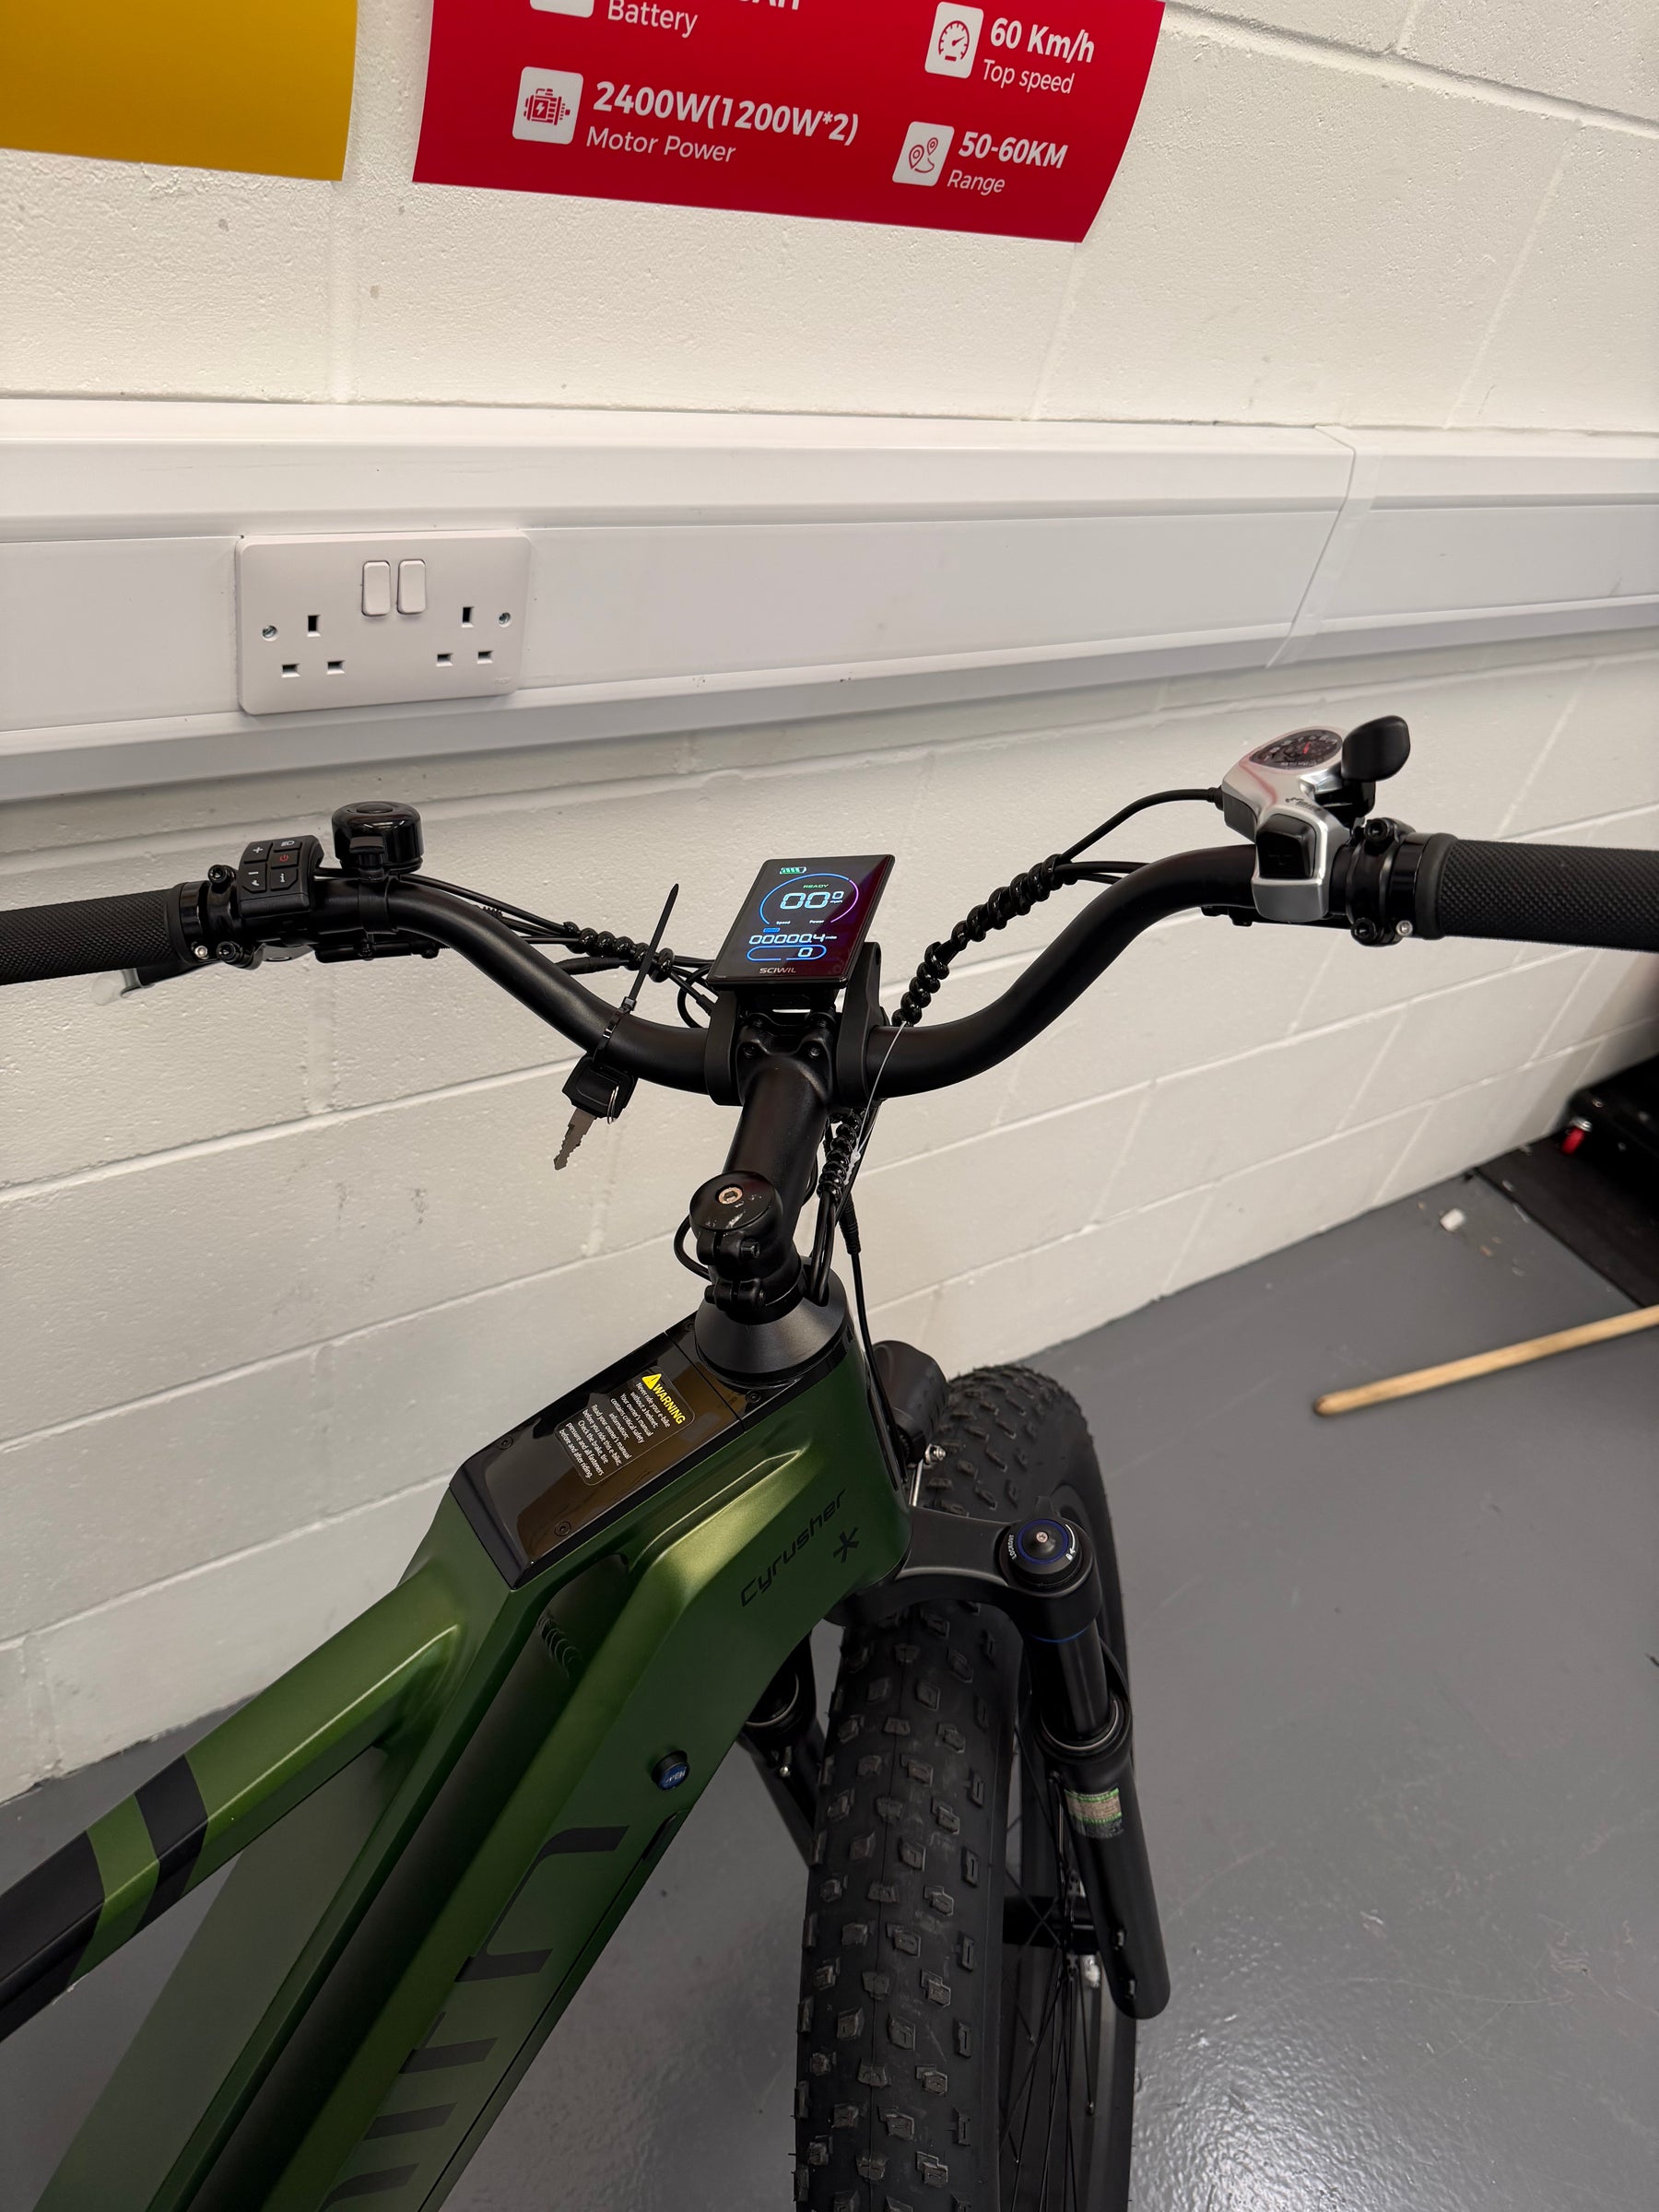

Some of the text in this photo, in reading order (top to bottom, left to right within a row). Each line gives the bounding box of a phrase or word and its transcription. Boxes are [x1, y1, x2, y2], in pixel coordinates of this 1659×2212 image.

[607, 0, 699, 39] Battery
[990, 18, 1095, 63] 60 Km/h
[982, 59, 1075, 94] Top speed
[586, 126, 736, 162] Motor Power
[958, 132, 1068, 169] 50-60KM
[947, 170, 1006, 195] Range
[797, 947, 813, 958] 0
[619, 1393, 653, 1436] Your owner's manual
[629, 1391, 645, 1408] without
[635, 1382, 670, 1428] Never ride your e-bike
[652, 1383, 685, 1424] WARNING
[559, 1428, 571, 1444] before
[582, 1408, 594, 1424] before
[589, 1422, 600, 1433] you
[596, 1430, 606, 1441] ride
[602, 1439, 612, 1450] this
[591, 1404, 632, 1459] Read your owner's manual
[610, 1397, 644, 1443] contains critical safety
[565, 1422, 582, 1441] pressure
[577, 1440, 589, 1450] and
[587, 1453, 604, 1476] fasteners
[567, 1442, 578, 1453] and
[572, 1452, 583, 1464] after
[577, 1419, 590, 1435] Check
[585, 1432, 594, 1442] the
[599, 1453, 608, 1464] tire
[740, 1488, 846, 1606] Cyrusher
